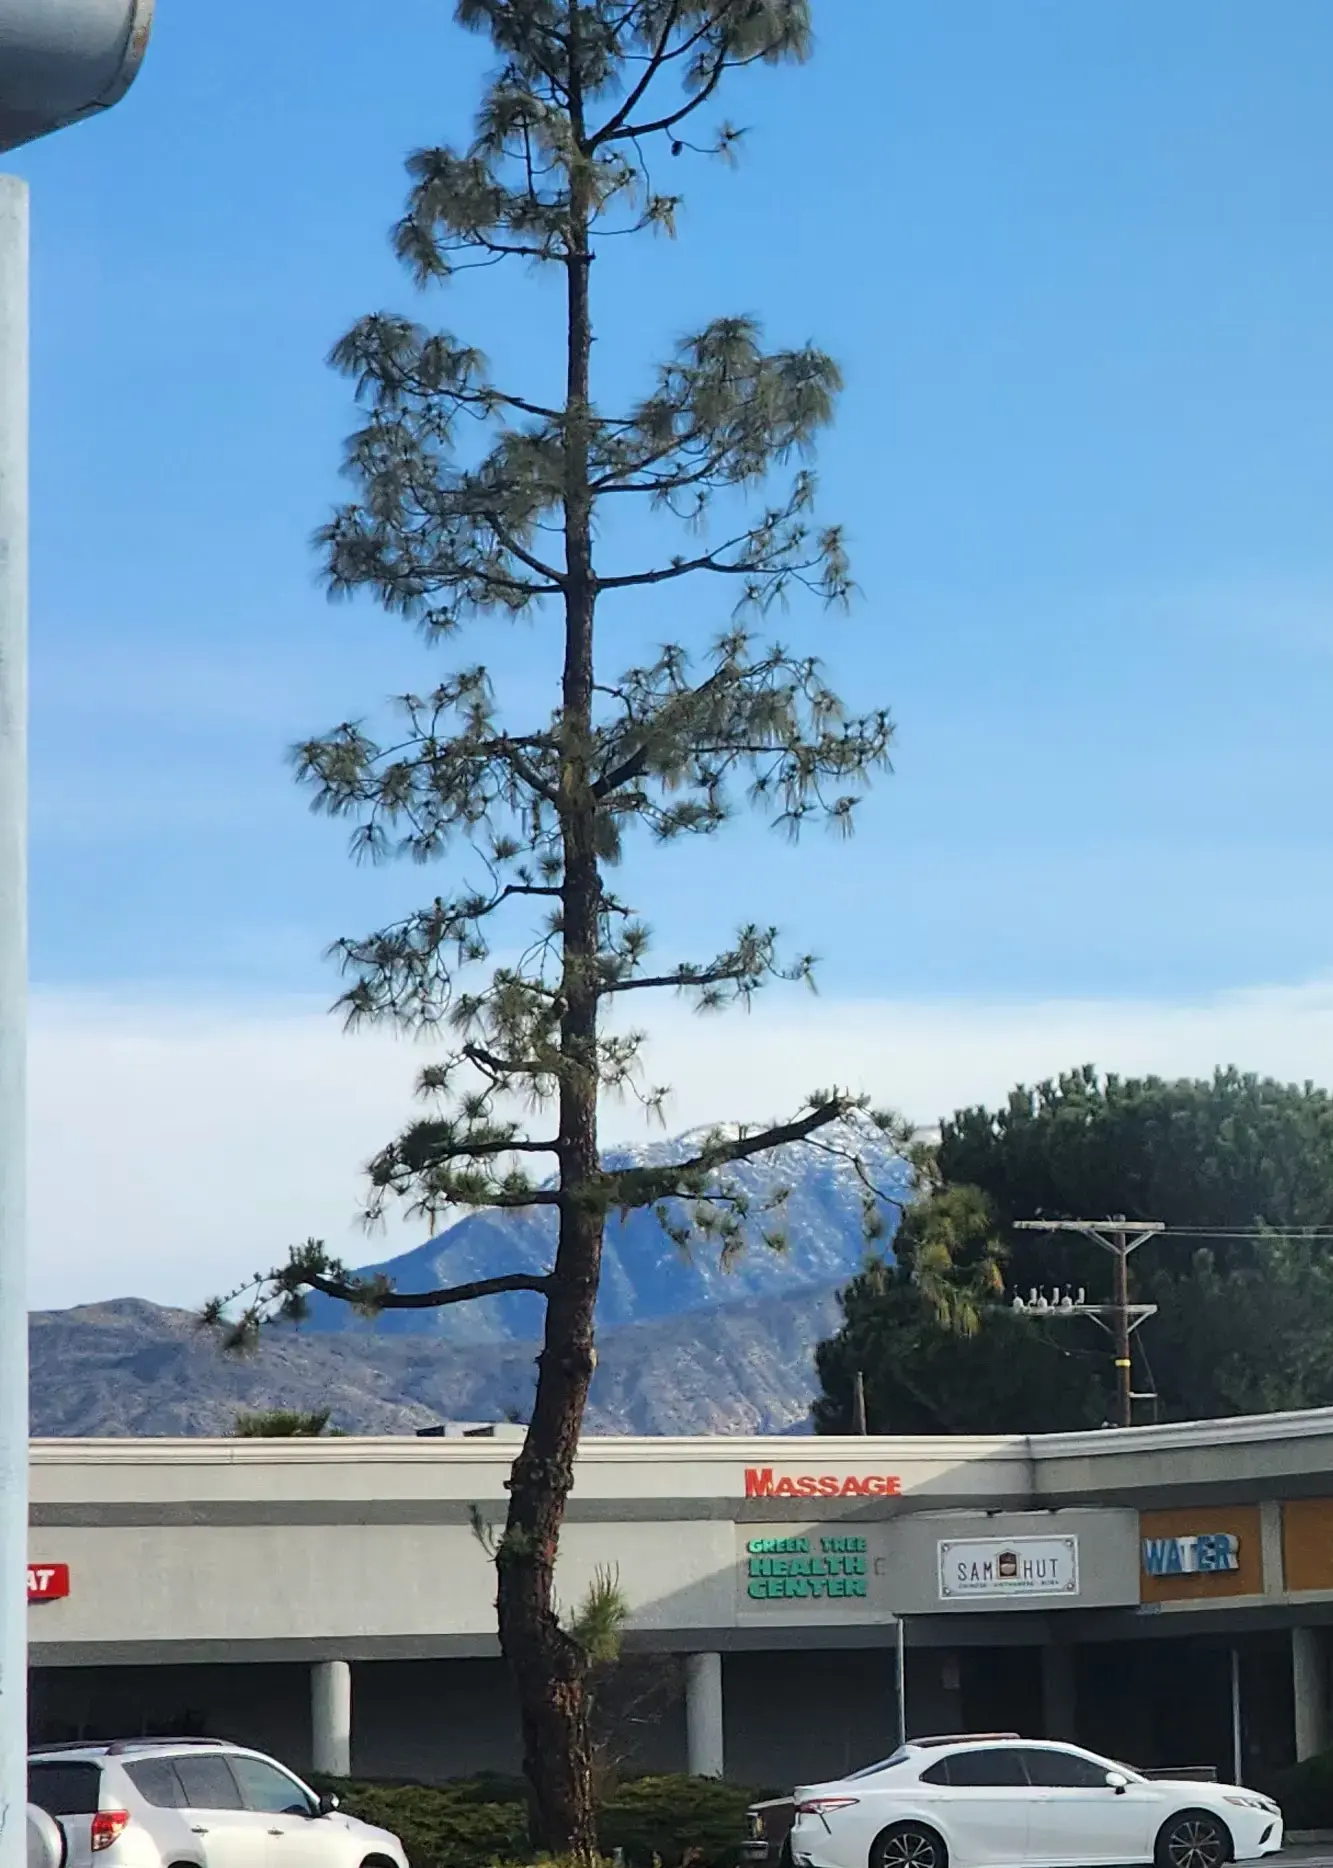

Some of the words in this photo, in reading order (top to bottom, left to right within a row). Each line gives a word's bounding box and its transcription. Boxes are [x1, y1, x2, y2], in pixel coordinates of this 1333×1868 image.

[747, 1537, 811, 1555] GREEN
[820, 1536, 868, 1554] TREE
[1145, 1533, 1240, 1575] WATER
[748, 1556, 867, 1579] HEALTH
[957, 1561, 993, 1582] SAM
[1023, 1558, 1058, 1579] HUT
[748, 1579, 869, 1600] CENTER
